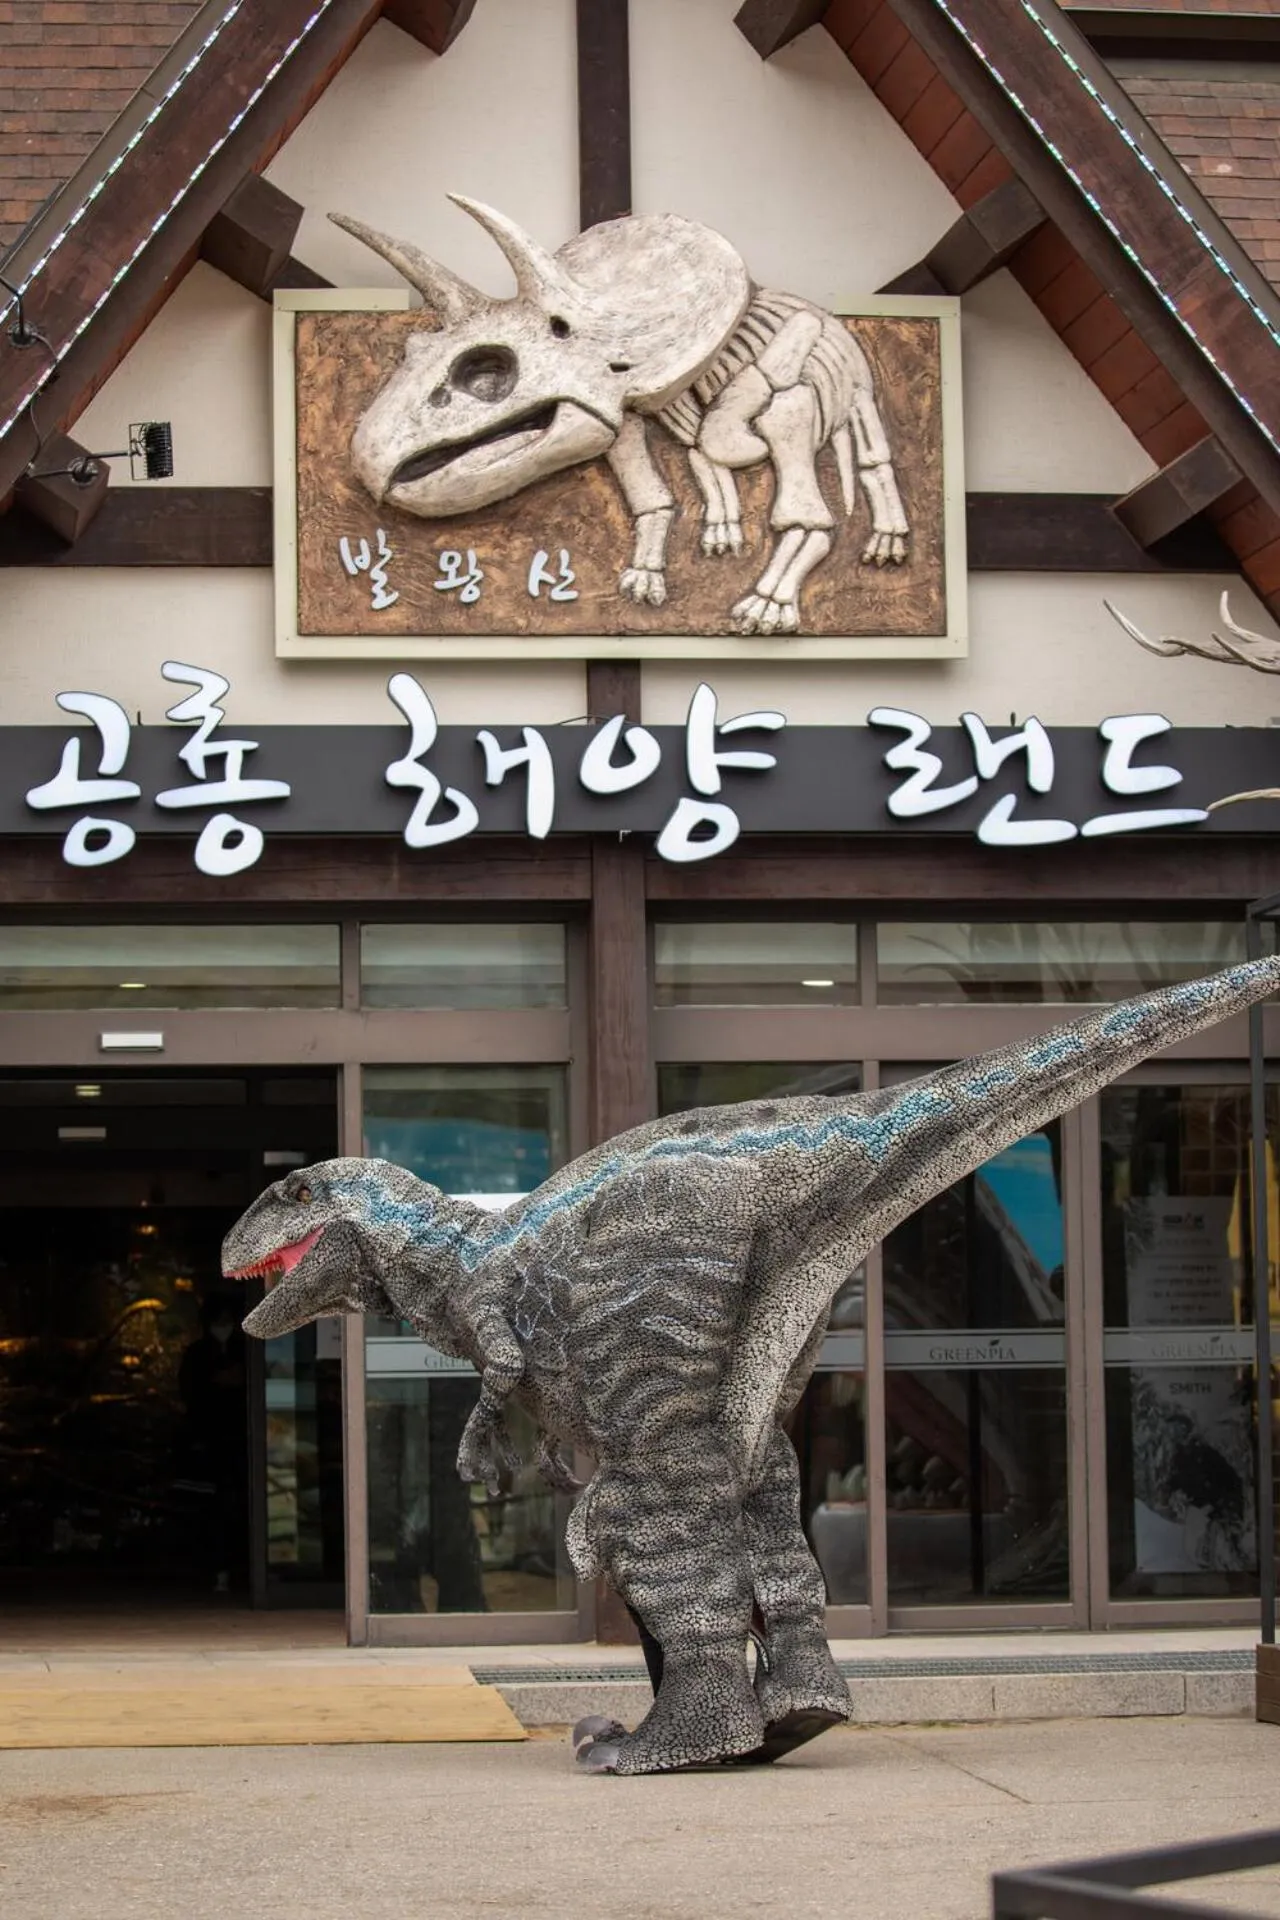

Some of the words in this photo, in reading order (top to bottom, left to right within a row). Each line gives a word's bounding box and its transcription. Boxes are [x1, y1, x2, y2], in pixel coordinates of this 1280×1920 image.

[26, 660, 291, 877] 공룡
[385, 672, 787, 863] 해양
[867, 705, 1210, 847] 랜드
[929, 1346, 1016, 1361] GREENPIA
[1151, 1341, 1237, 1358] GREENPIA
[1169, 1382, 1212, 1395] SMITH
